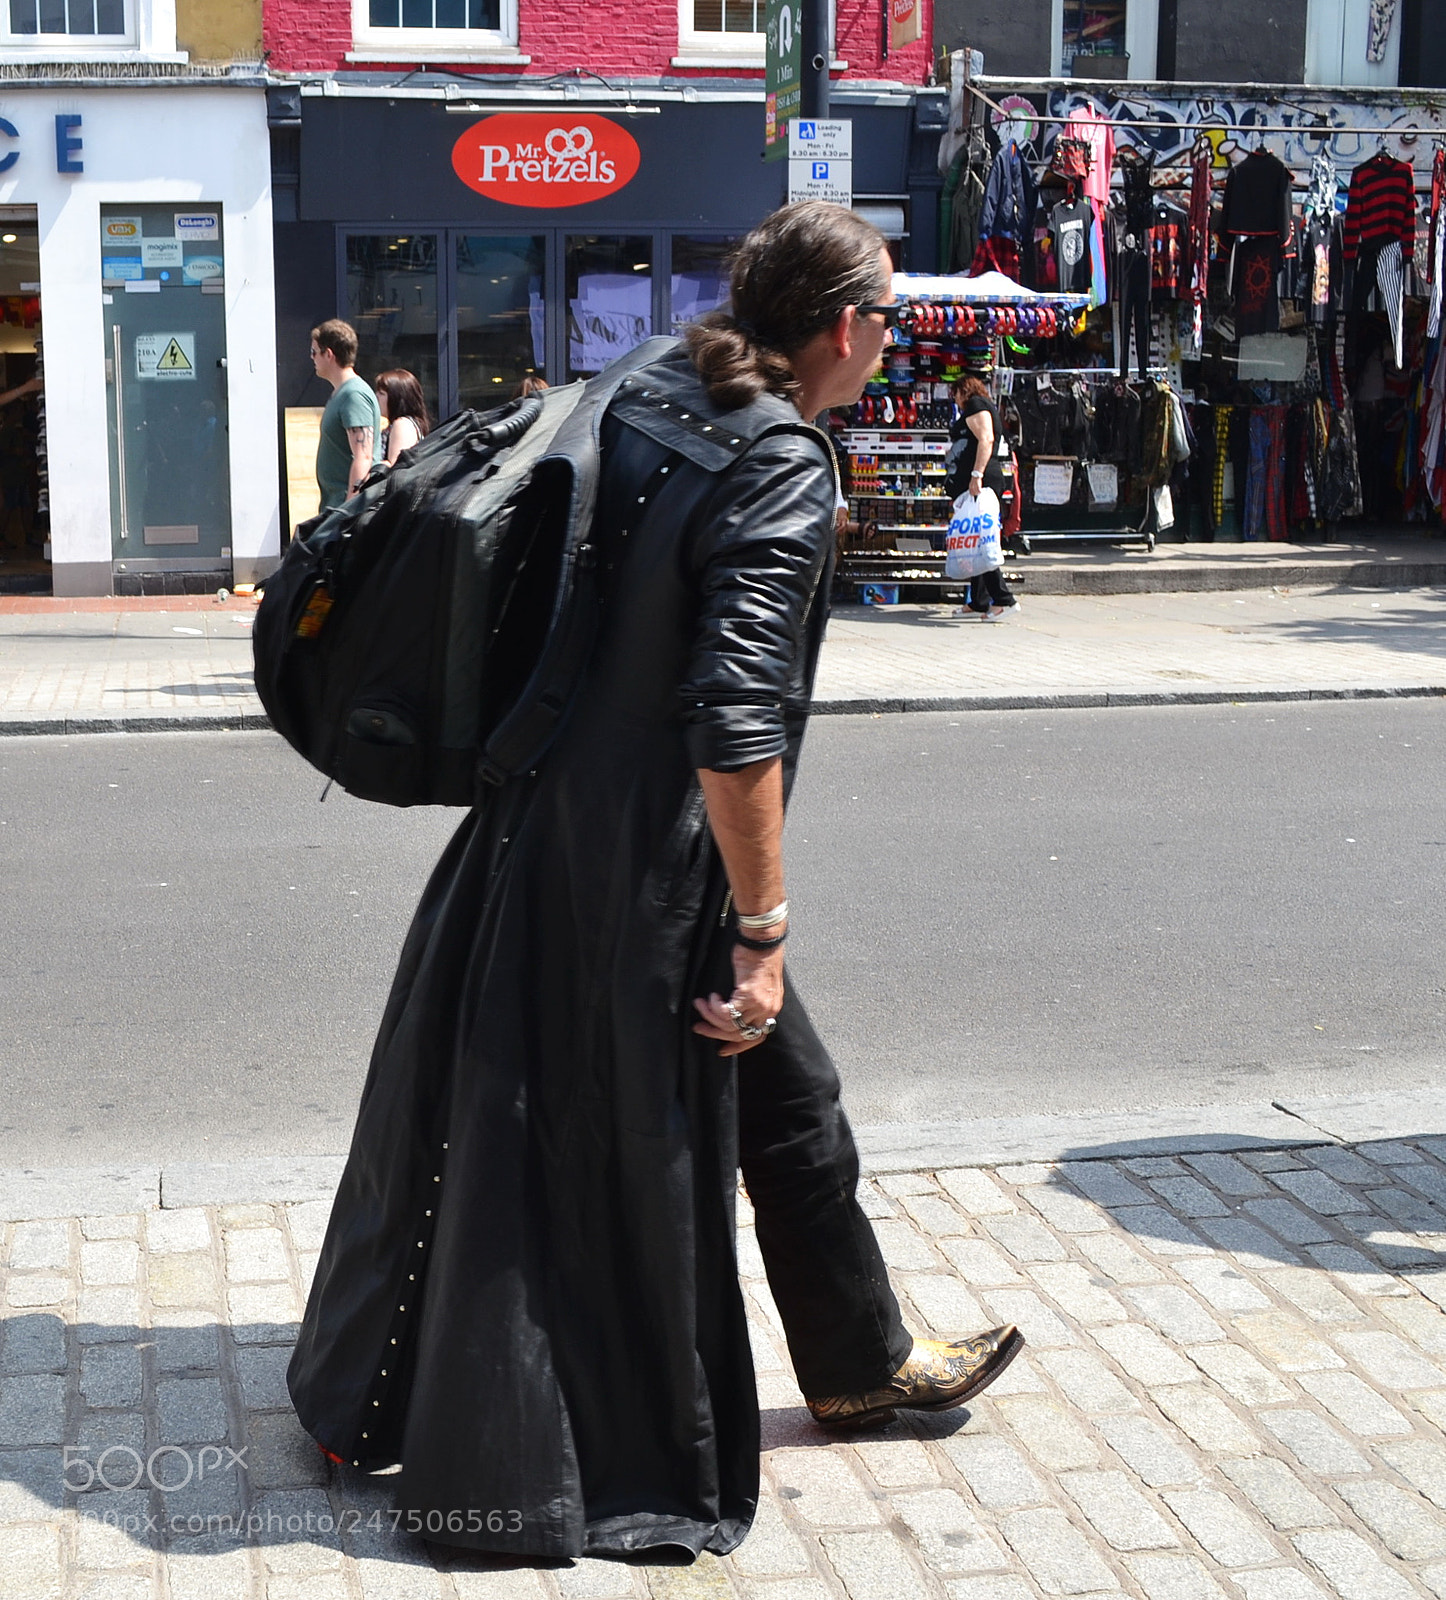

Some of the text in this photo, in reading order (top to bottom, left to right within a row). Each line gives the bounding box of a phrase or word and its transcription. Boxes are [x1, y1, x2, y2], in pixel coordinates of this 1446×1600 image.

[516, 143, 543, 159] Mr.
[478, 145, 616, 183] Pretzels
[815, 163, 827, 179] P
[147, 243, 178, 252] magimix
